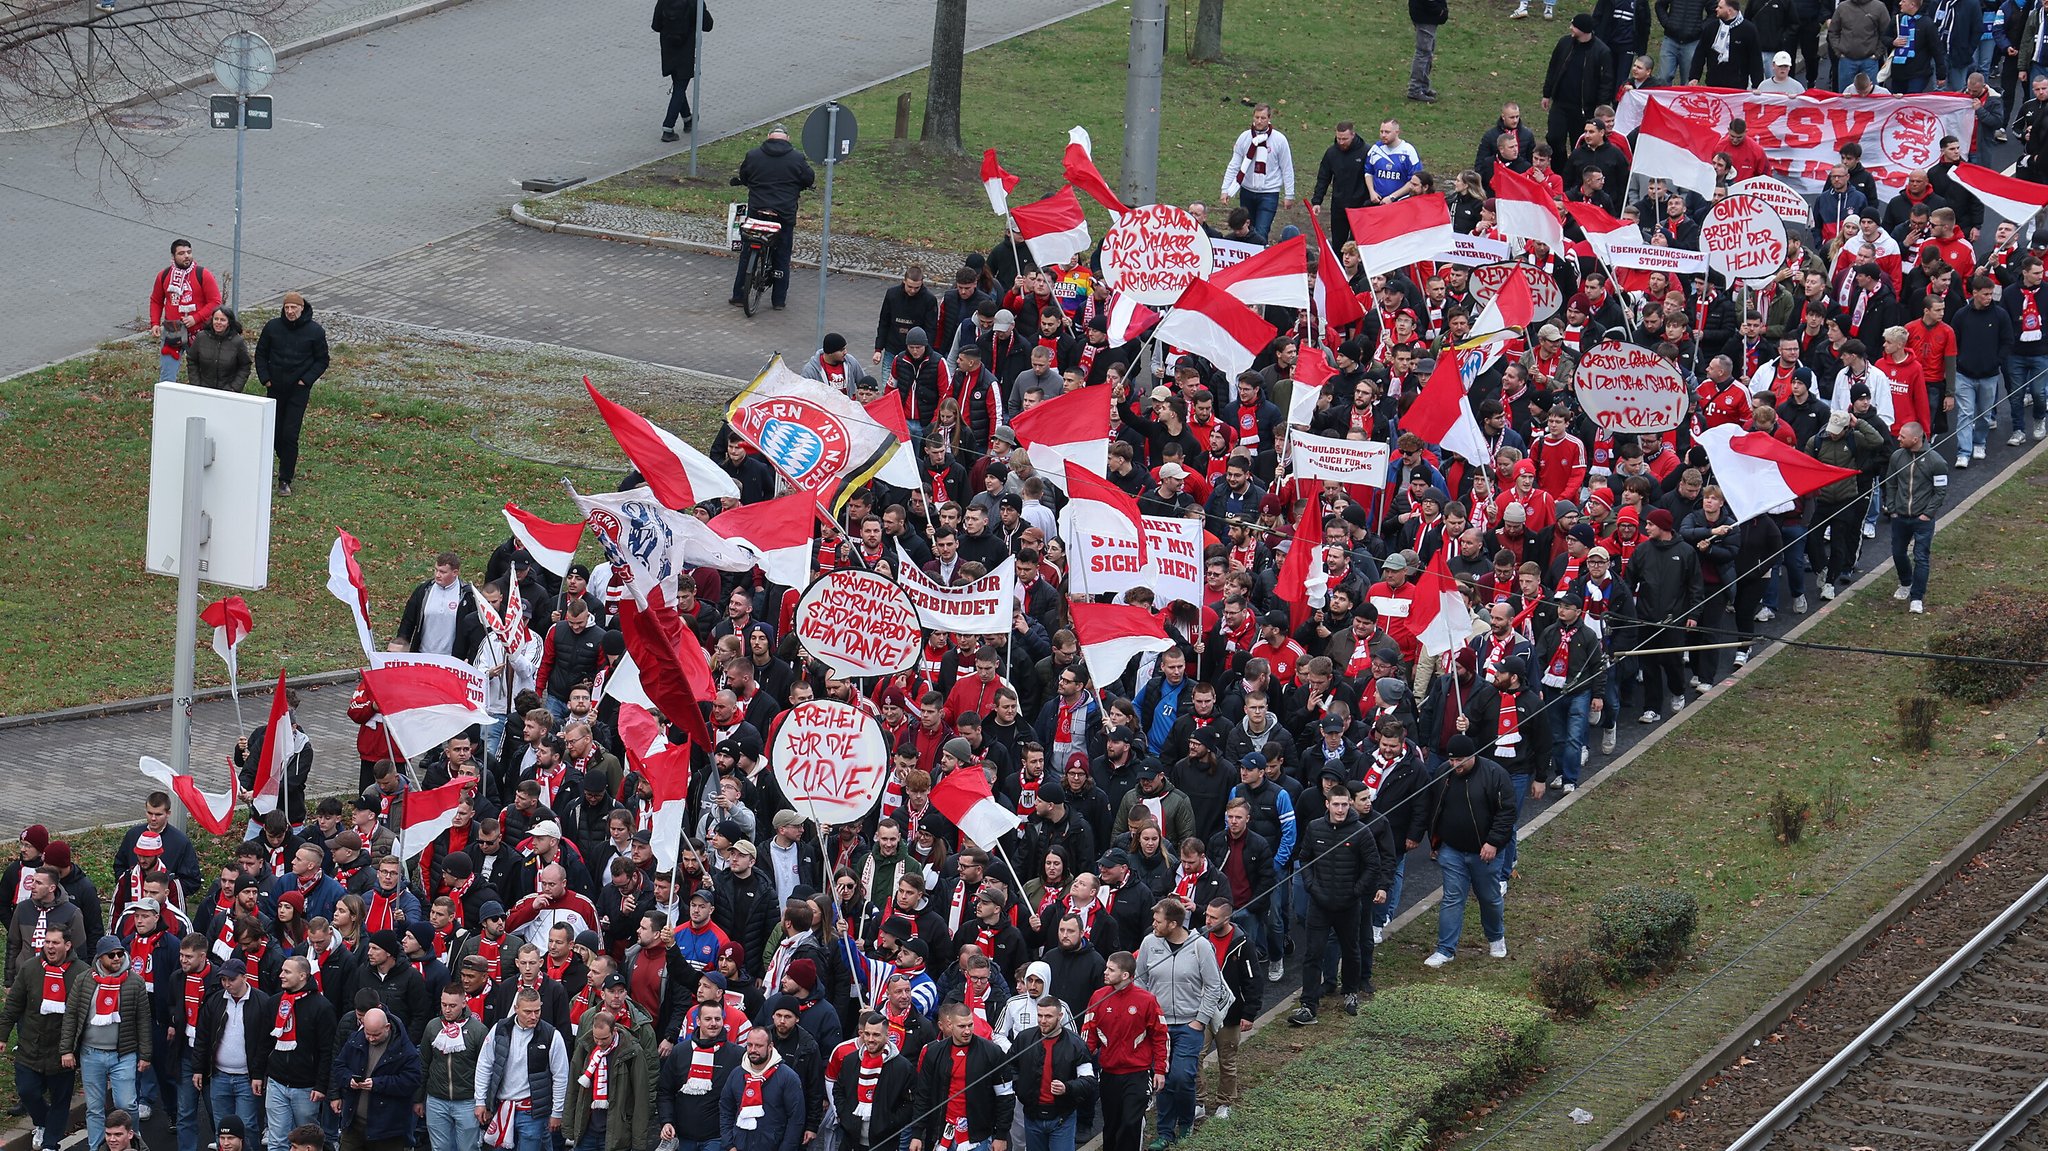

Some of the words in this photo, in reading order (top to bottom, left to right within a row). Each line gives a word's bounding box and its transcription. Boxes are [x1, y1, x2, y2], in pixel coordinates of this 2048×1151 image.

[1743, 102, 1874, 151] KSV
[1378, 170, 1401, 181] FABER
[1714, 195, 1763, 221] @IMK:
[1703, 218, 1752, 241] BRENNT
[1709, 235, 1741, 251] EUCH
[1747, 229, 1777, 246] DER
[1109, 249, 1141, 270] ALS
[1639, 257, 1679, 268] STOPPEN
[1726, 242, 1782, 271] HELM?
[1054, 282, 1076, 291] FABER
[1319, 456, 1342, 464] AUCH
[1168, 537, 1195, 558] MIT
[821, 589, 915, 625] INSTRUMENT
[799, 617, 844, 647] NEIN
[843, 630, 912, 670] DANKE!
[1162, 705, 1173, 716] 27
[786, 731, 822, 759] FÜR
[826, 733, 860, 760] DIE
[785, 757, 884, 800] KURVE!
